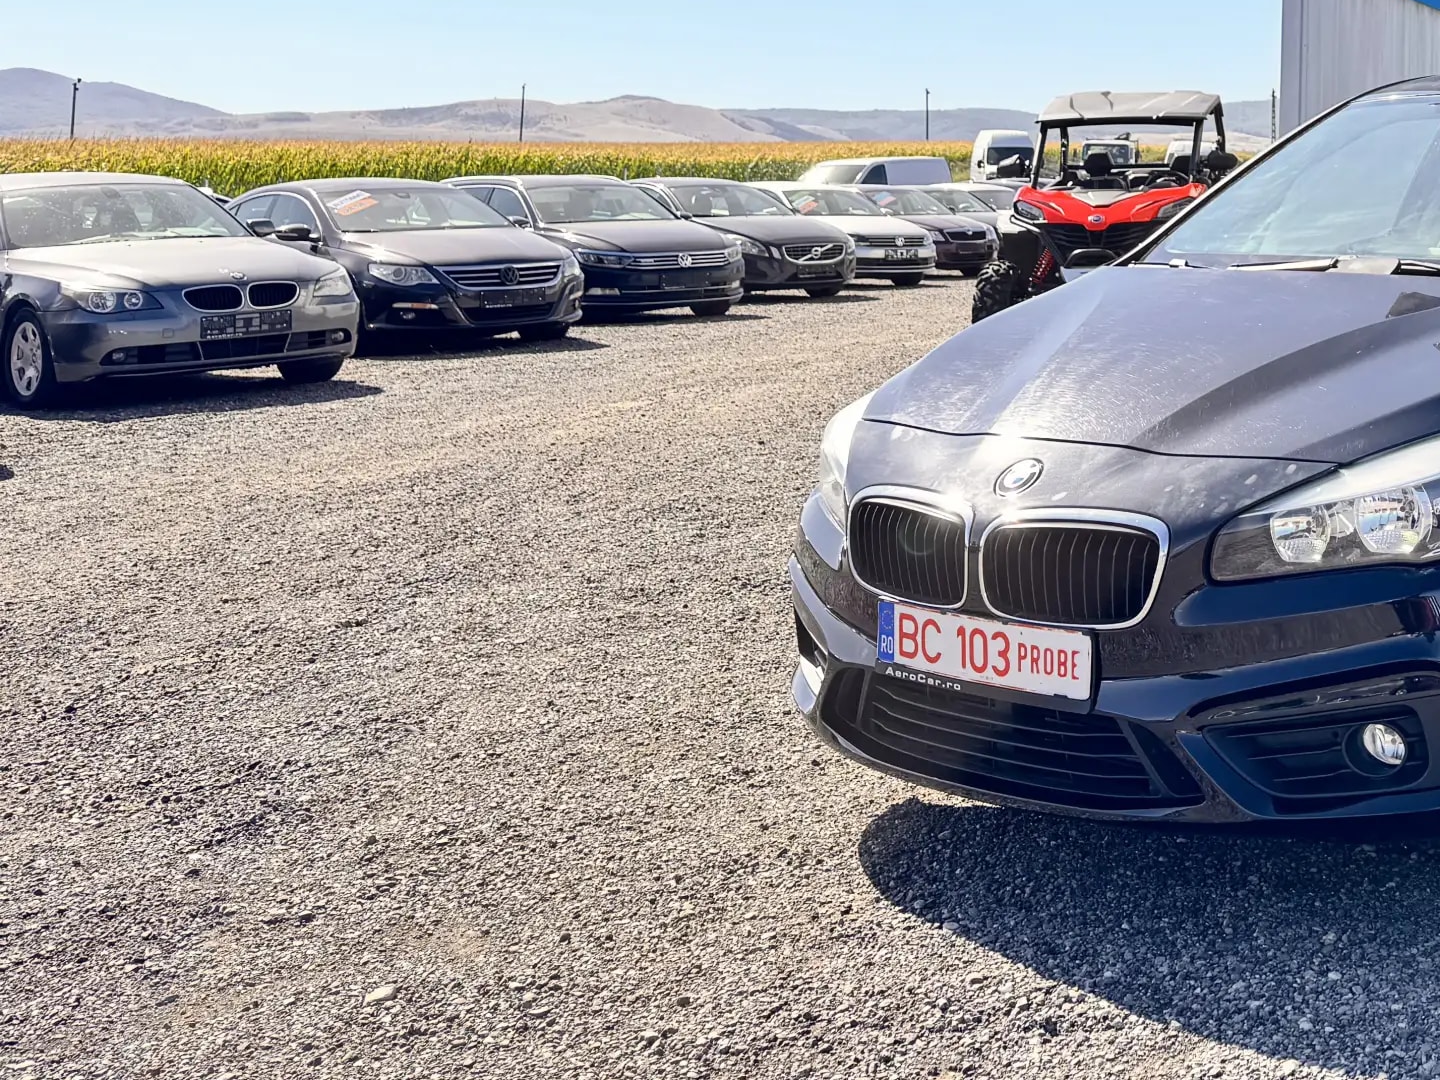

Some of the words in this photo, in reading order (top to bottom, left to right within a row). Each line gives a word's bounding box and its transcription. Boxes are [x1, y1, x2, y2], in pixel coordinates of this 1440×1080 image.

[881, 634, 894, 653] RO
[899, 613, 942, 664] BC
[957, 625, 1010, 677] 103
[1018, 642, 1080, 680] PROBE
[885, 666, 961, 690] AeroCar.ro
